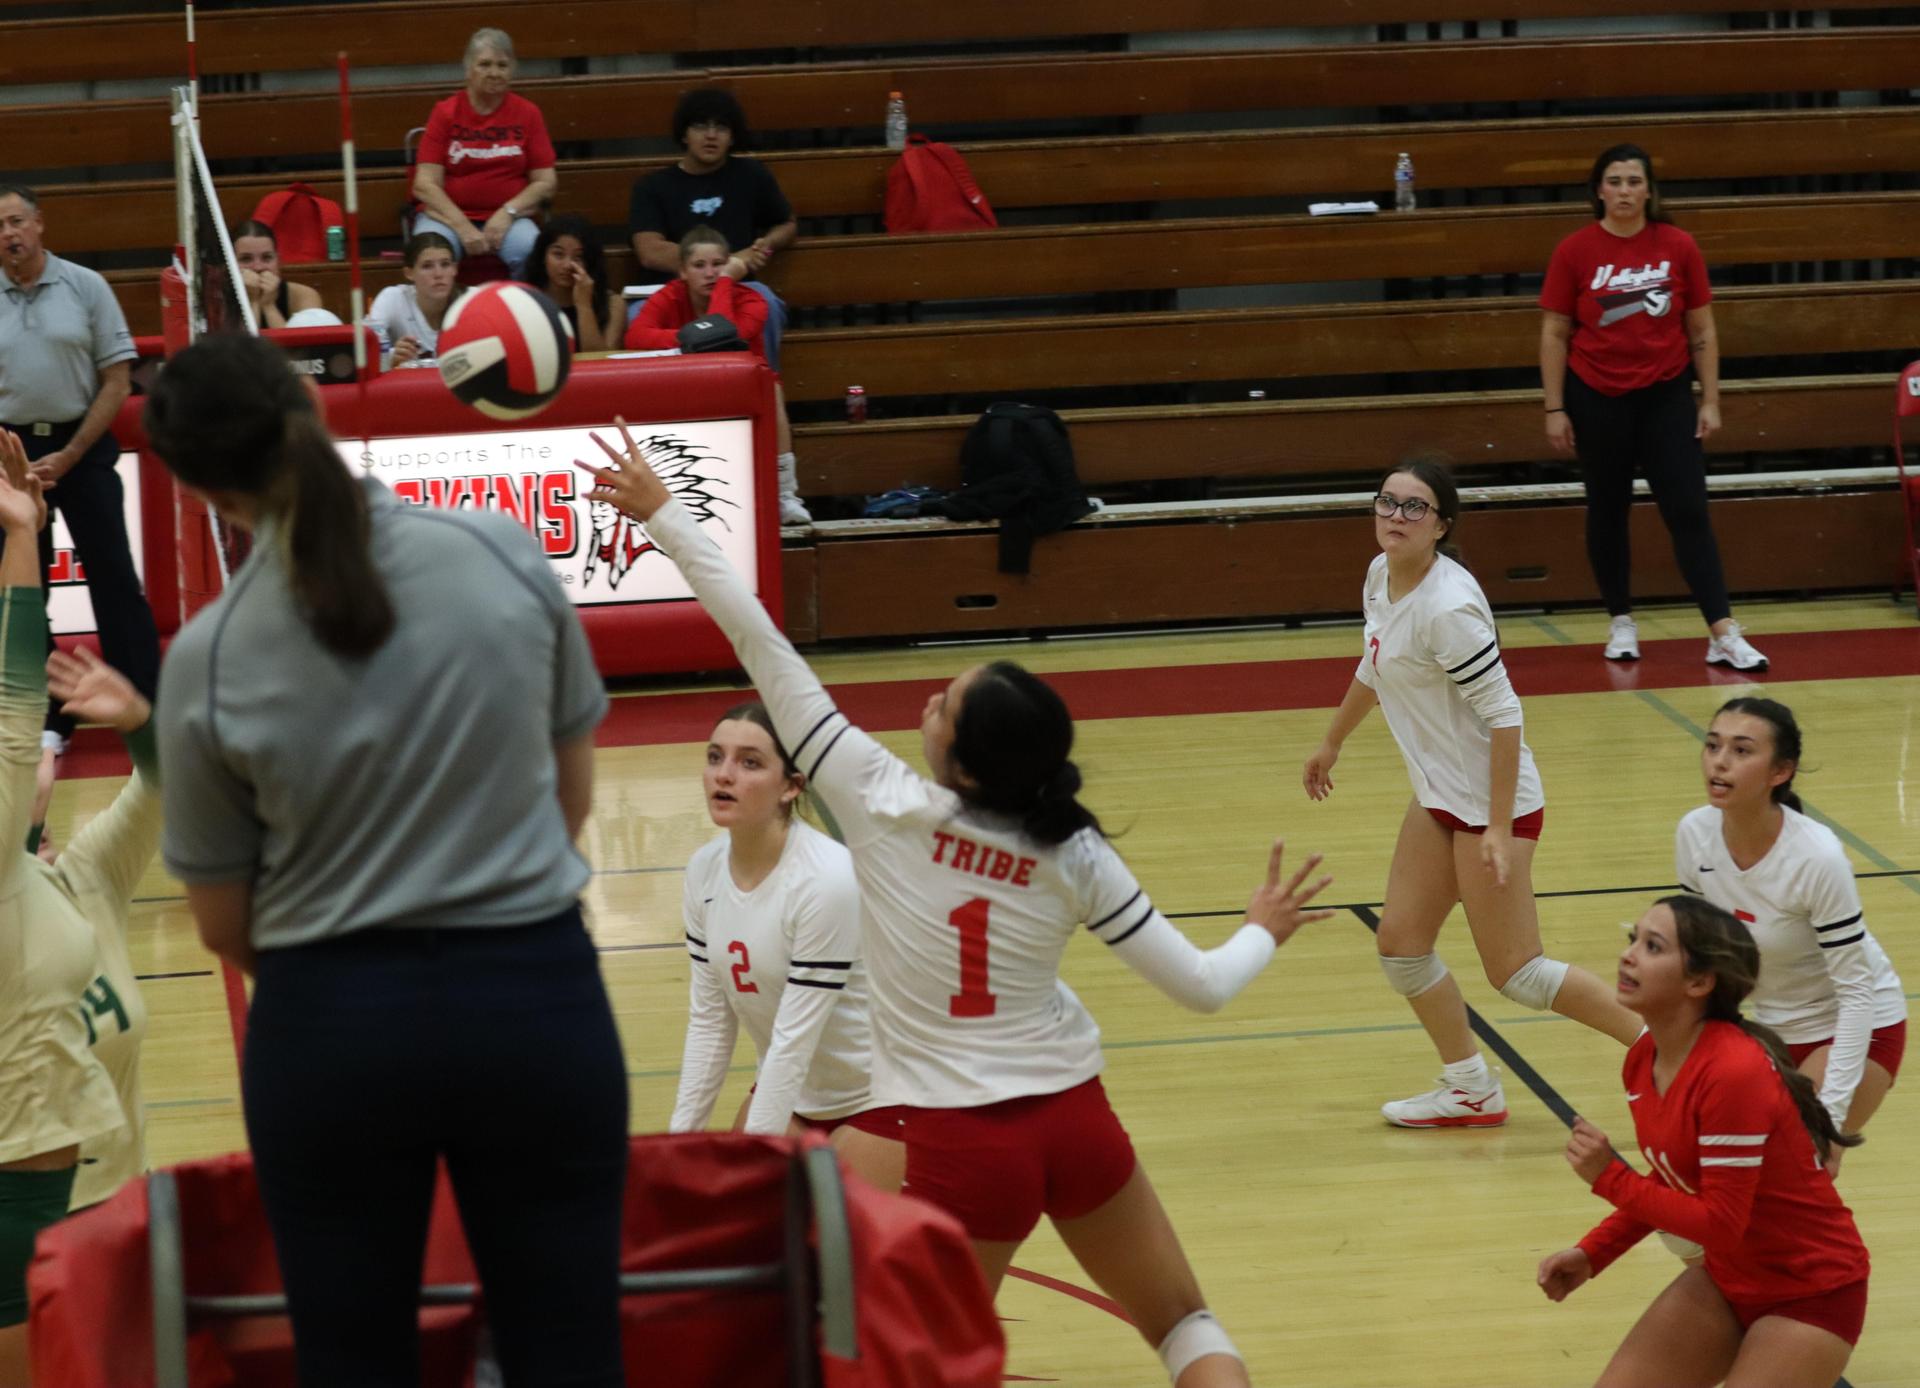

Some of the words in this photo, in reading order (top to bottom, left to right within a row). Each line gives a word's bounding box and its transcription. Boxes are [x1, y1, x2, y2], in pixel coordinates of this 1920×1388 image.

[359, 448, 489, 470] Supports
[502, 442, 553, 460] The
[932, 831, 1037, 888] TRIBE
[728, 940, 759, 993] 2
[948, 896, 997, 1018] 1
